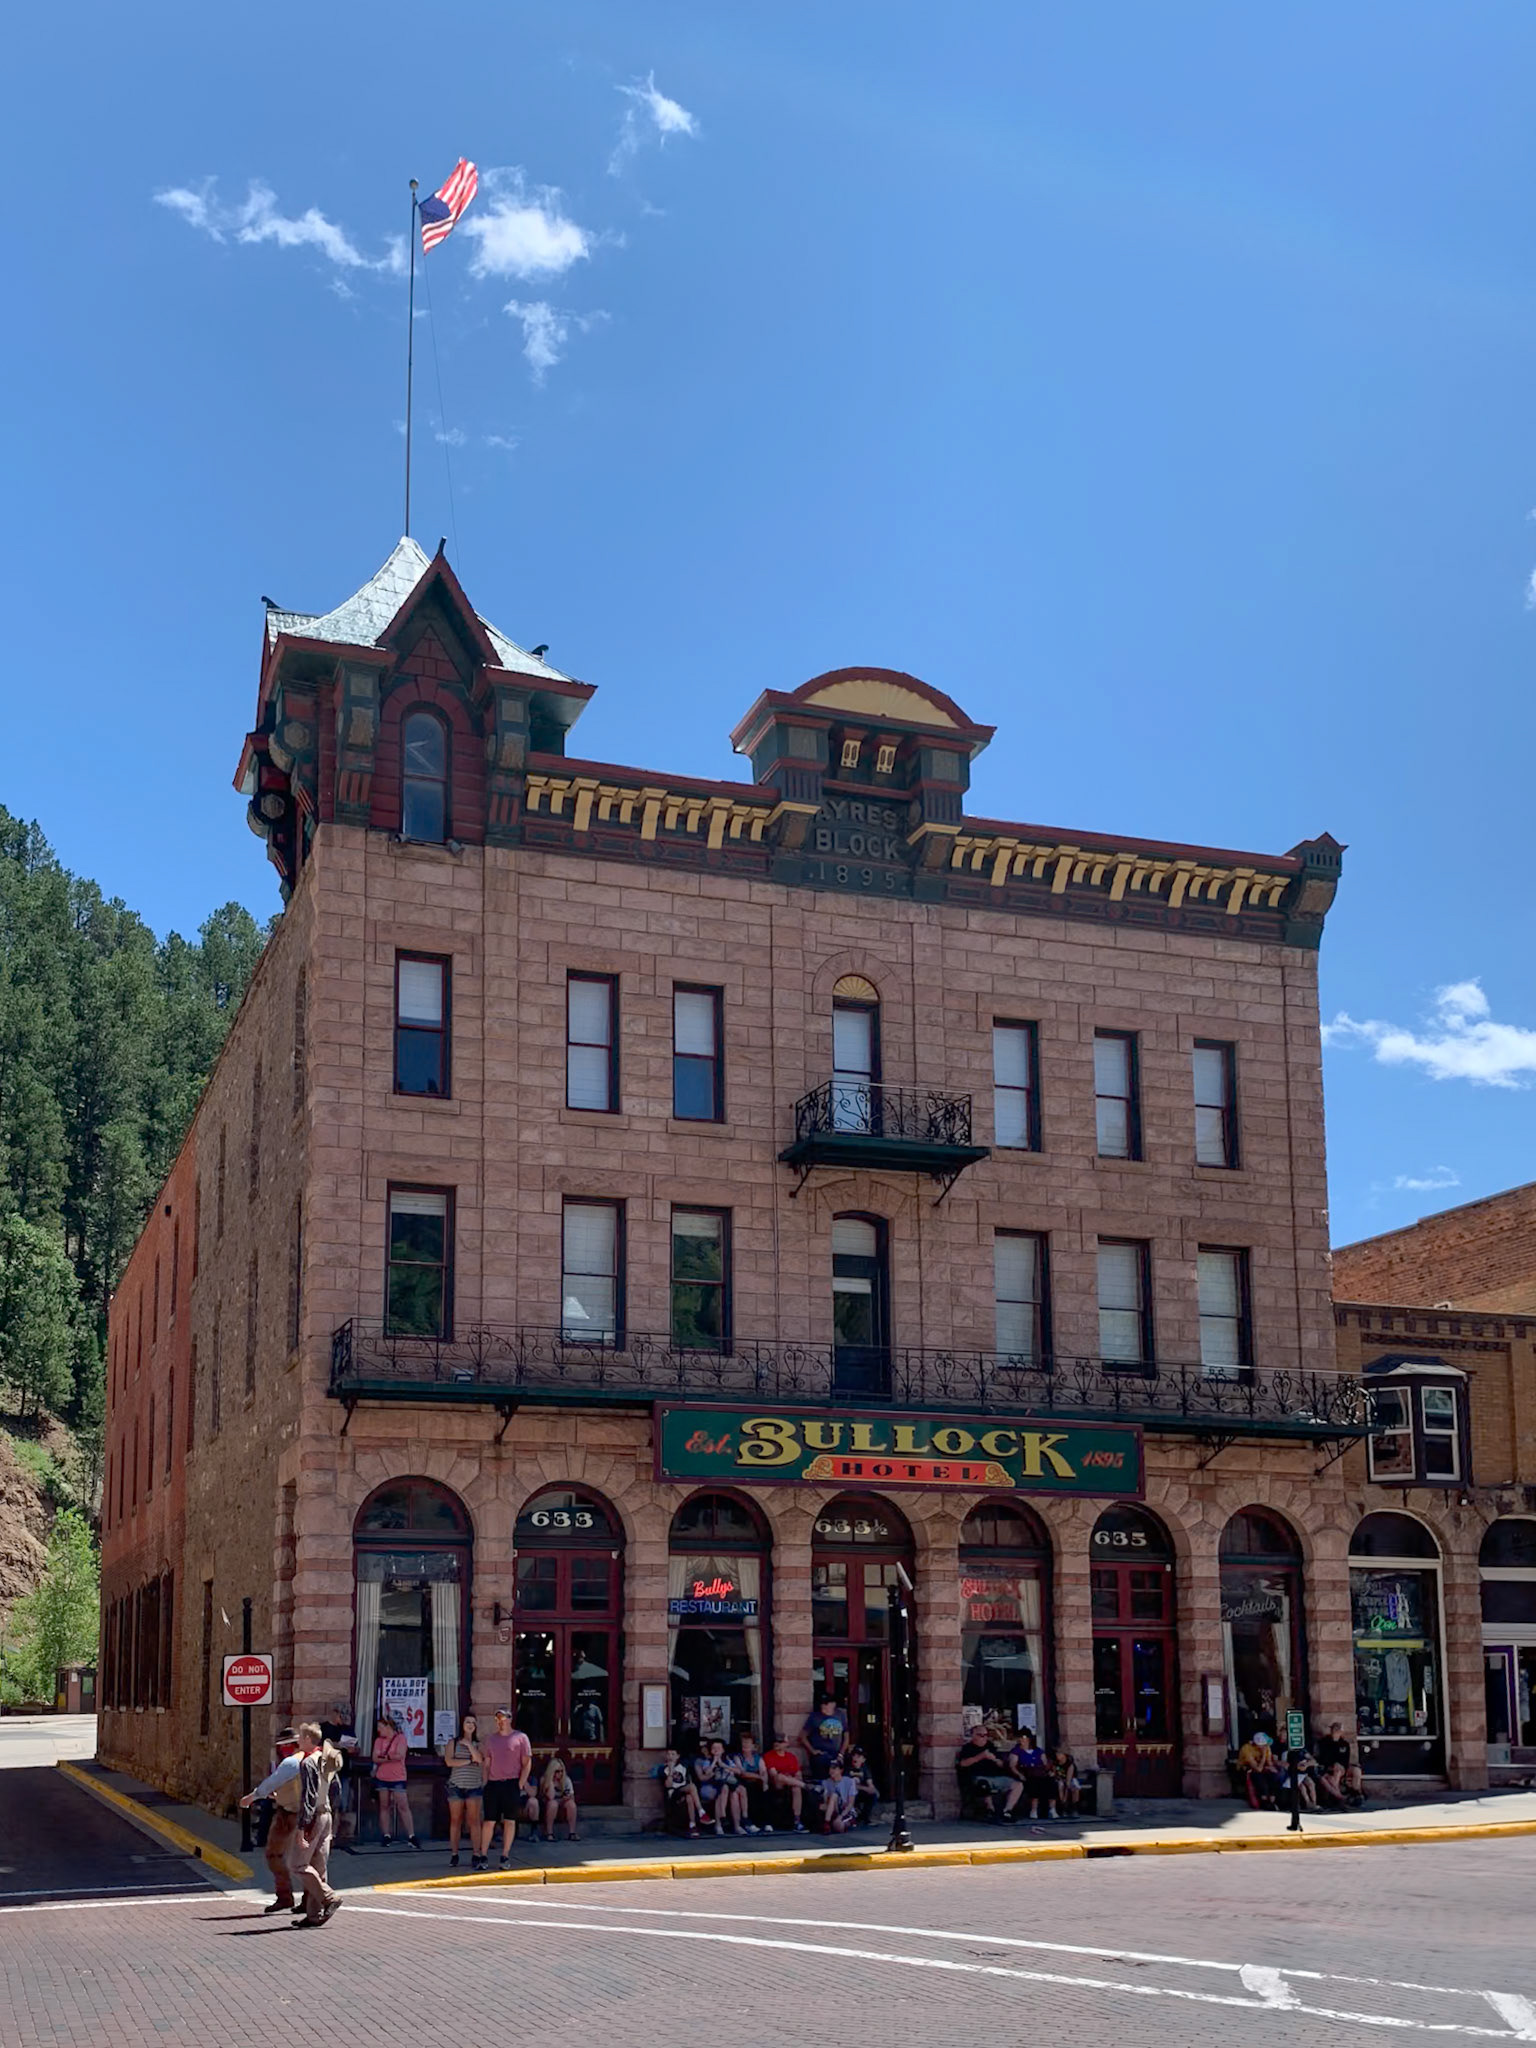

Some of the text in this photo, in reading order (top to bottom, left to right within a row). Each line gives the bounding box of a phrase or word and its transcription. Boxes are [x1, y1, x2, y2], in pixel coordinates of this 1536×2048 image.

[815, 800, 898, 830] AYRES
[815, 827, 899, 860] BLOCK
[684, 1417, 1125, 1479] Est. BULLOCK 1895
[841, 1461, 979, 1481] HOTEL
[531, 1510, 594, 1529] 633
[1094, 1529, 1148, 1547] 635
[669, 1600, 757, 1614] RESTAURANT
[231, 1665, 265, 1674] DO NOT
[234, 1686, 261, 1695] ENTER
[385, 1679, 426, 1688] TALL BOY
[385, 1689, 426, 1697] TUESDAY
[406, 1706, 424, 1737] $2
